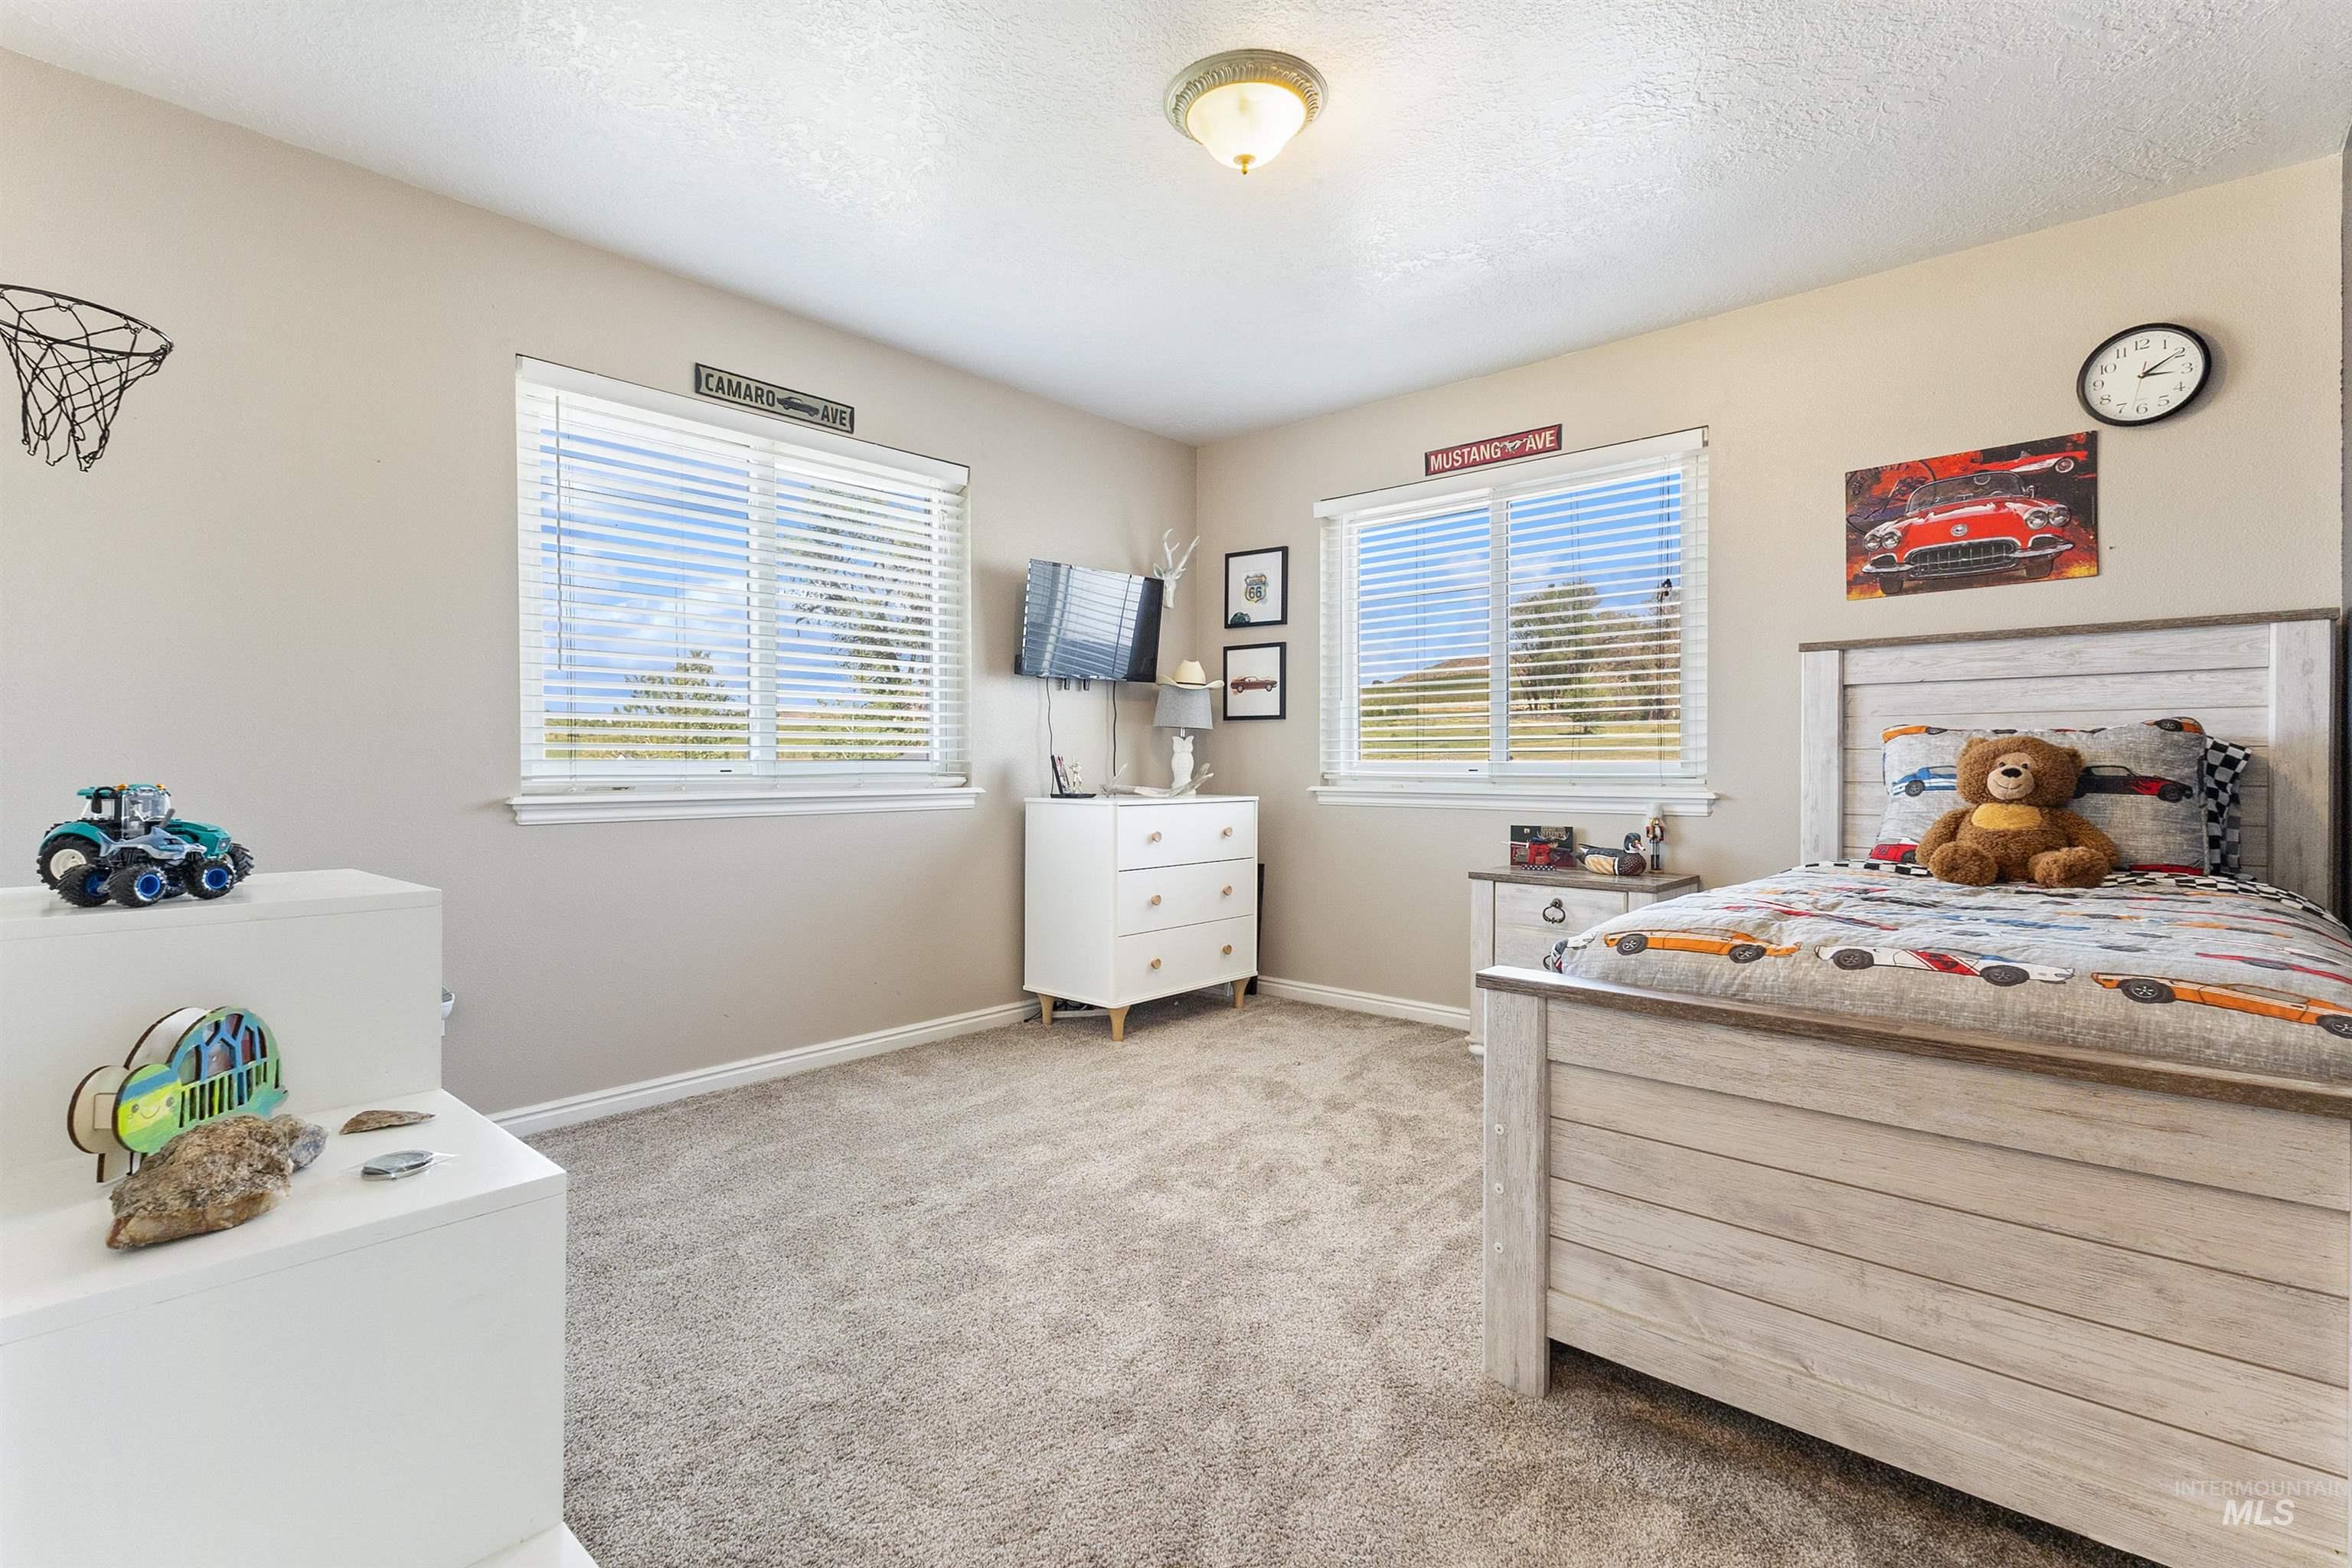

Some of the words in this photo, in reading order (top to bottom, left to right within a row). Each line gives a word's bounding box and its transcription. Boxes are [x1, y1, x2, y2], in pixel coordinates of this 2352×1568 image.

[2135, 338, 2150, 351] 12
[2163, 339, 2167, 349] 1
[2115, 348, 2127, 359] 11
[2174, 347, 2186, 358] 2
[2100, 363, 2117, 375] 10
[2181, 362, 2194, 374] 3
[2092, 380, 2105, 390] 9
[2173, 381, 2186, 392] 4
[704, 372, 776, 408] CAMARO
[820, 405, 848, 427] AVE
[2099, 394, 2112, 406] 8
[2158, 394, 2170, 407] 5
[2116, 403, 2127, 413] 7
[2136, 403, 2148, 414] 6
[1429, 441, 1501, 472] MUSTANG
[1525, 430, 1556, 452] AVE
[1249, 586, 1263, 599] 66
